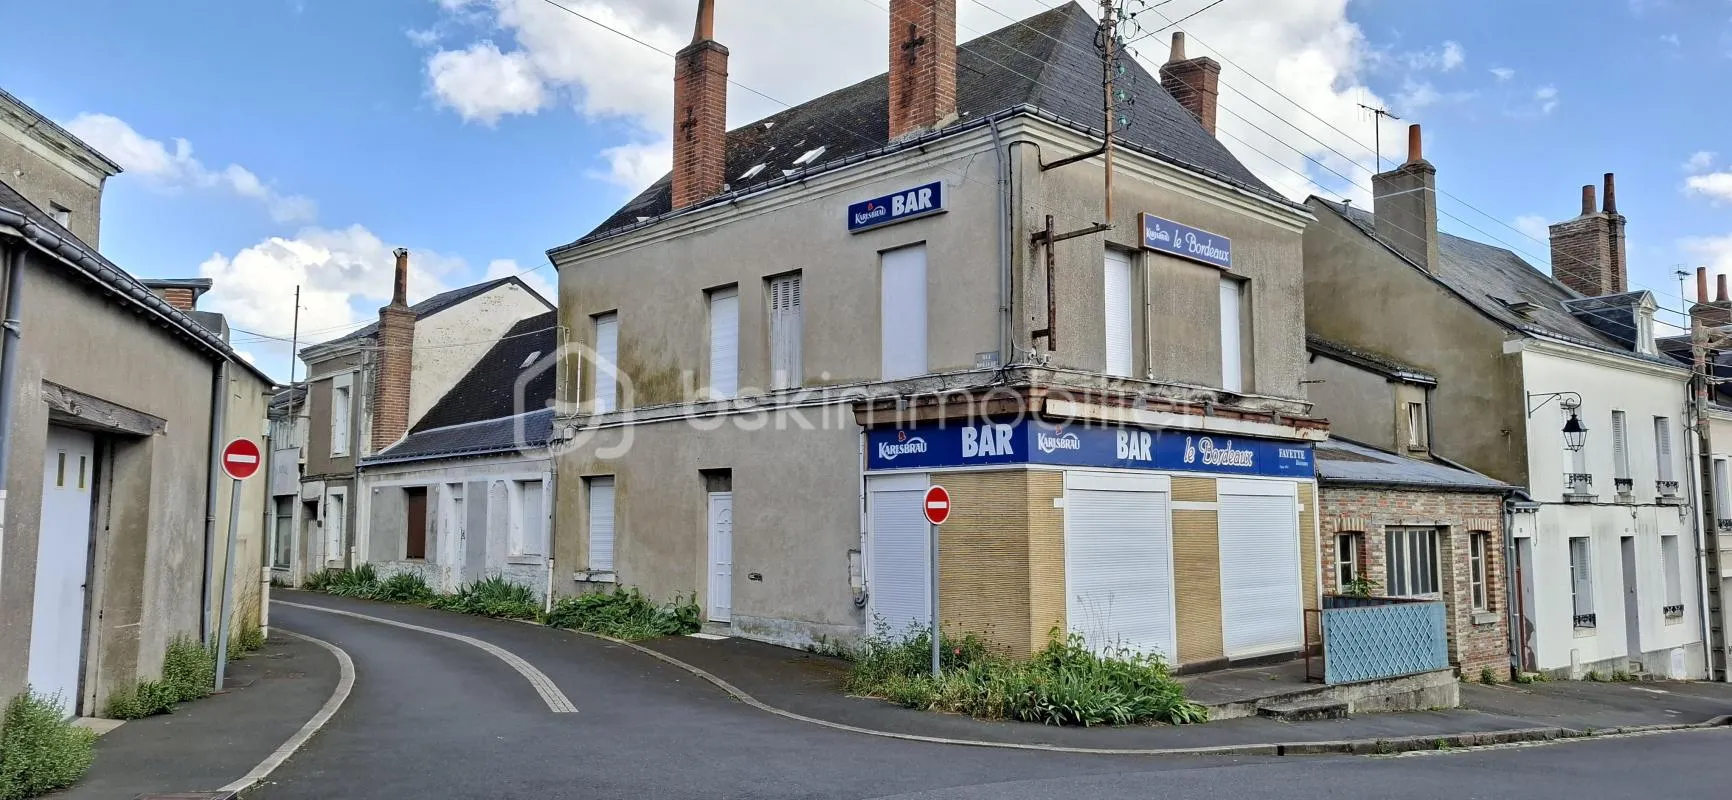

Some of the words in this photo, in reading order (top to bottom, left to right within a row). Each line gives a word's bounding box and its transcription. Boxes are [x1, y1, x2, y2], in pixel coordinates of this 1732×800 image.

[892, 188, 932, 216] BAR
[1173, 229, 1182, 249] le
[1185, 232, 1229, 262] Bordeaux
[961, 423, 1014, 458] BAR
[1116, 430, 1152, 460] BAR
[1183, 436, 1196, 463] le
[1199, 436, 1253, 467] Bordeaux
[1278, 447, 1305, 460] FAYETTE
